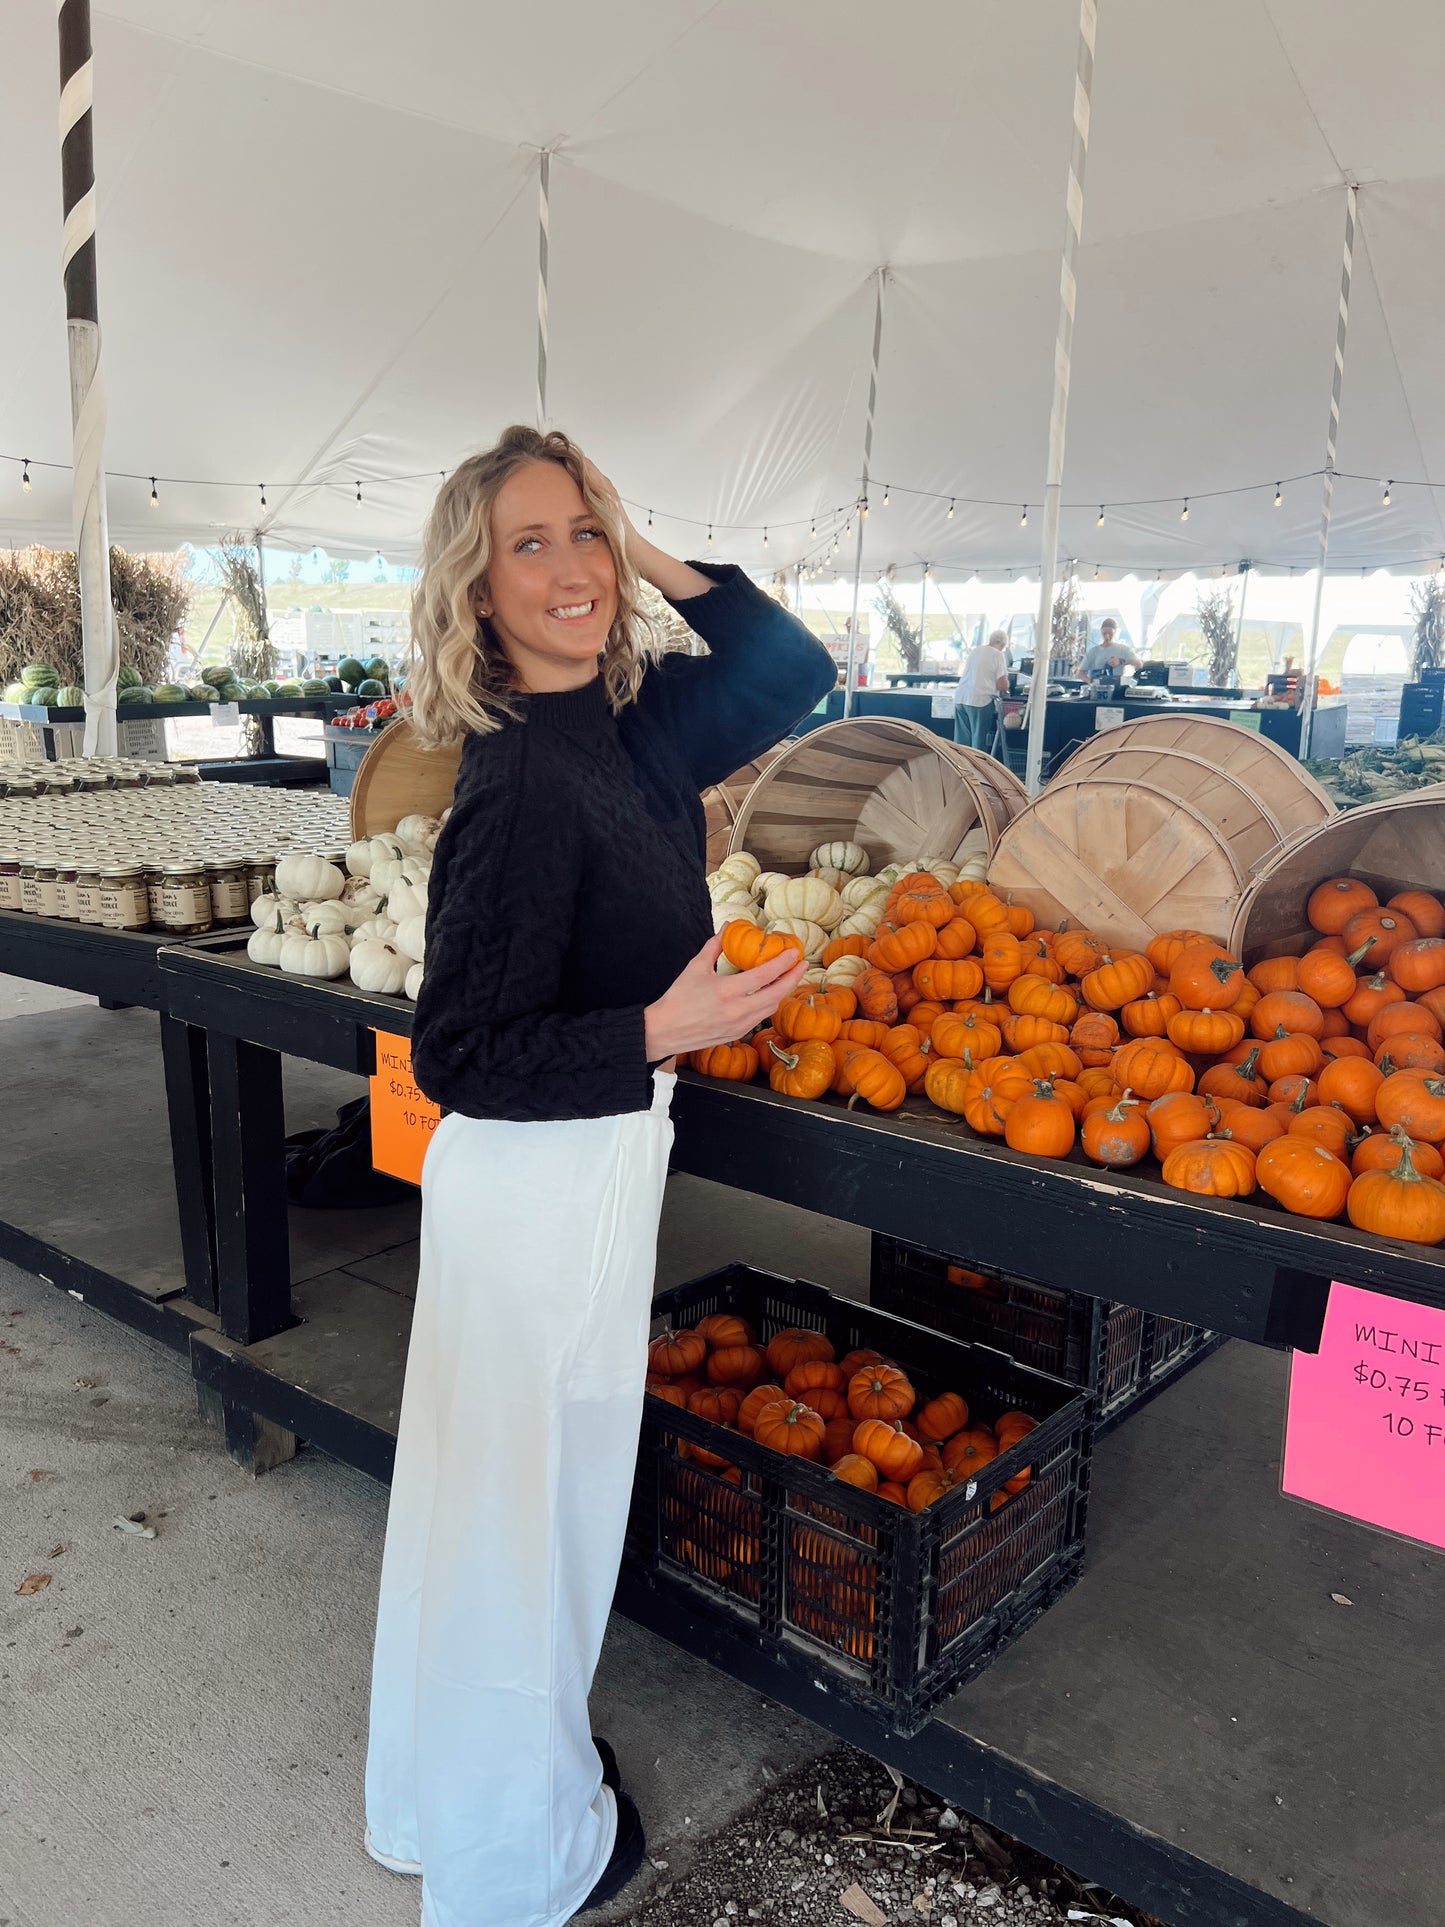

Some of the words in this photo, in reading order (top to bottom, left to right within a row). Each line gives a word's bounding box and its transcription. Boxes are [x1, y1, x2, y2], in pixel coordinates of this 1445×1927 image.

[382, 1053, 414, 1073] MINI
[389, 1078, 421, 1102] $0.75
[403, 1111, 417, 1126] 10
[1355, 1323, 1442, 1365] MINI
[1353, 1359, 1430, 1401] $0.75
[1382, 1412, 1414, 1437] 10
[1423, 1423, 1445, 1446] F
